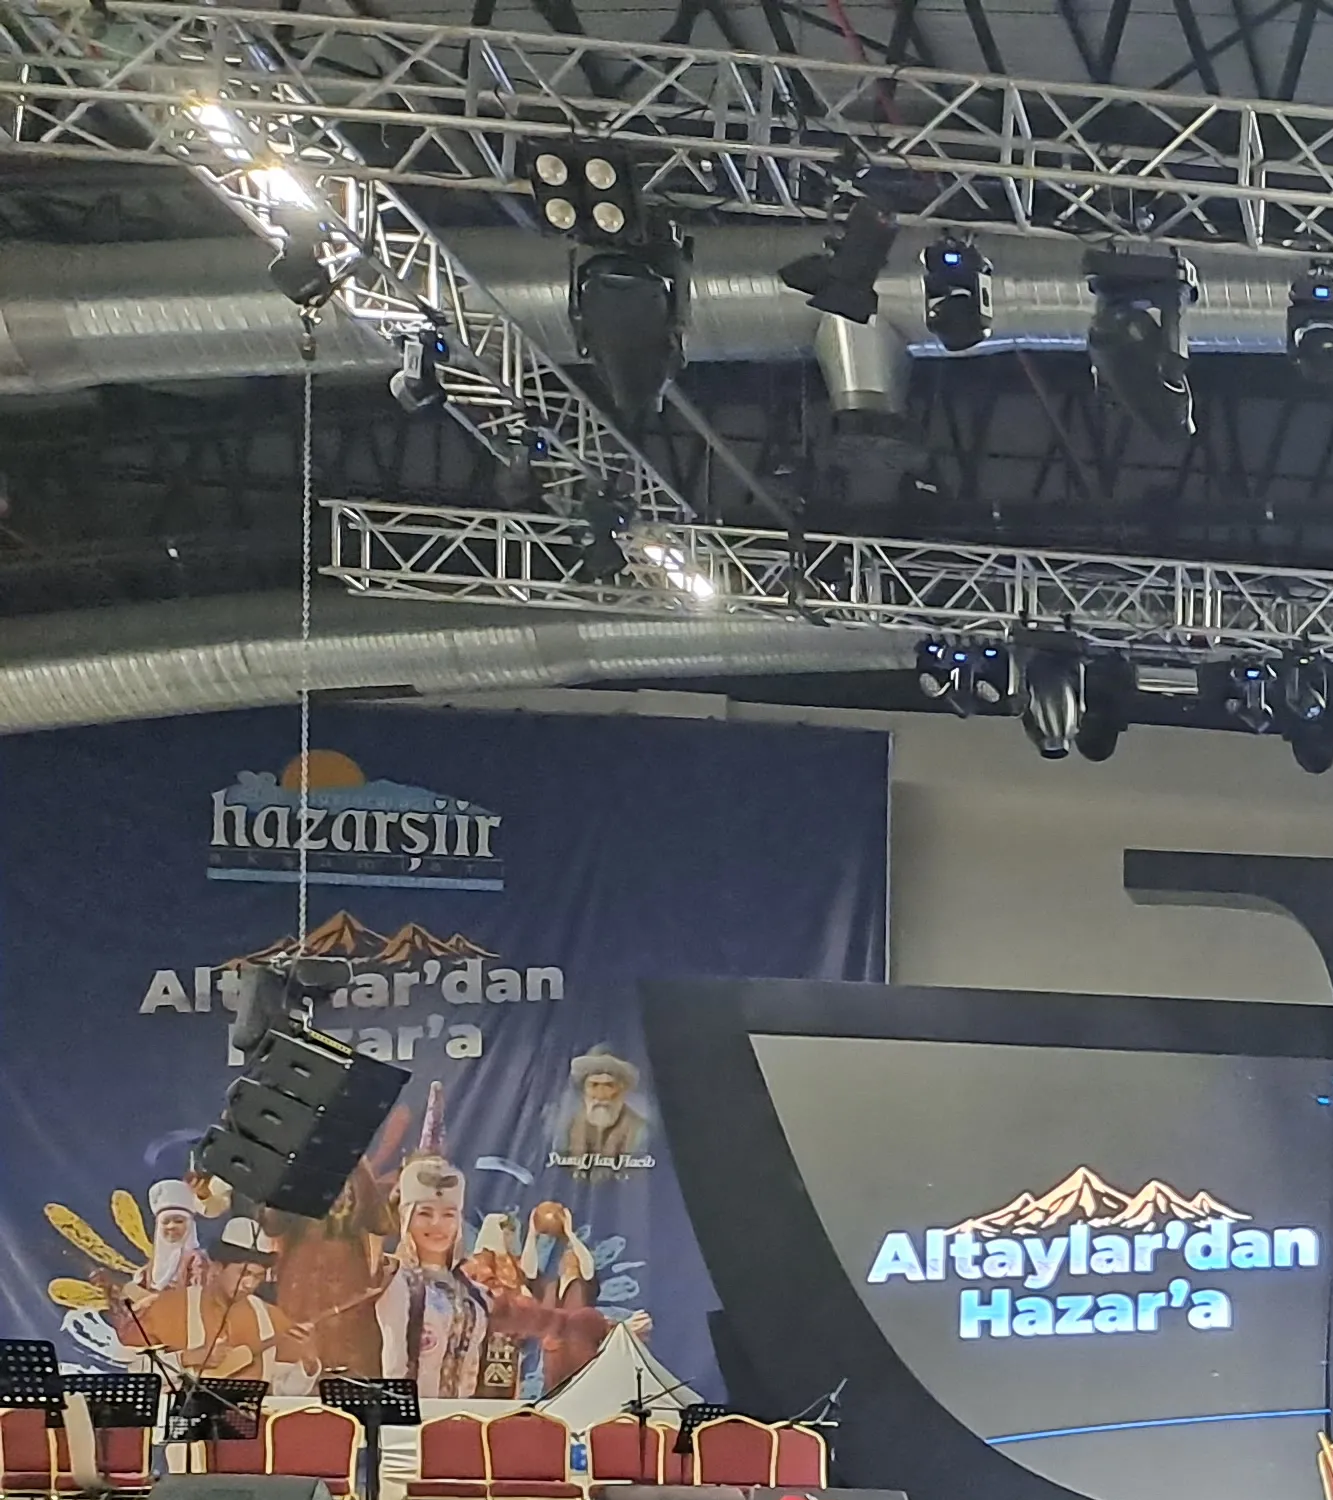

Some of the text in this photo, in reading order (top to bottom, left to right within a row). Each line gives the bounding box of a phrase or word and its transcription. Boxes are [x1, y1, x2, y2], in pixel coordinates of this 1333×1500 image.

[210, 787, 502, 872] hazarşiir
[139, 958, 565, 1014] Altar'dan
[867, 1217, 1319, 1290] Altaylar'dan
[959, 1278, 1232, 1340] Hazar'a
